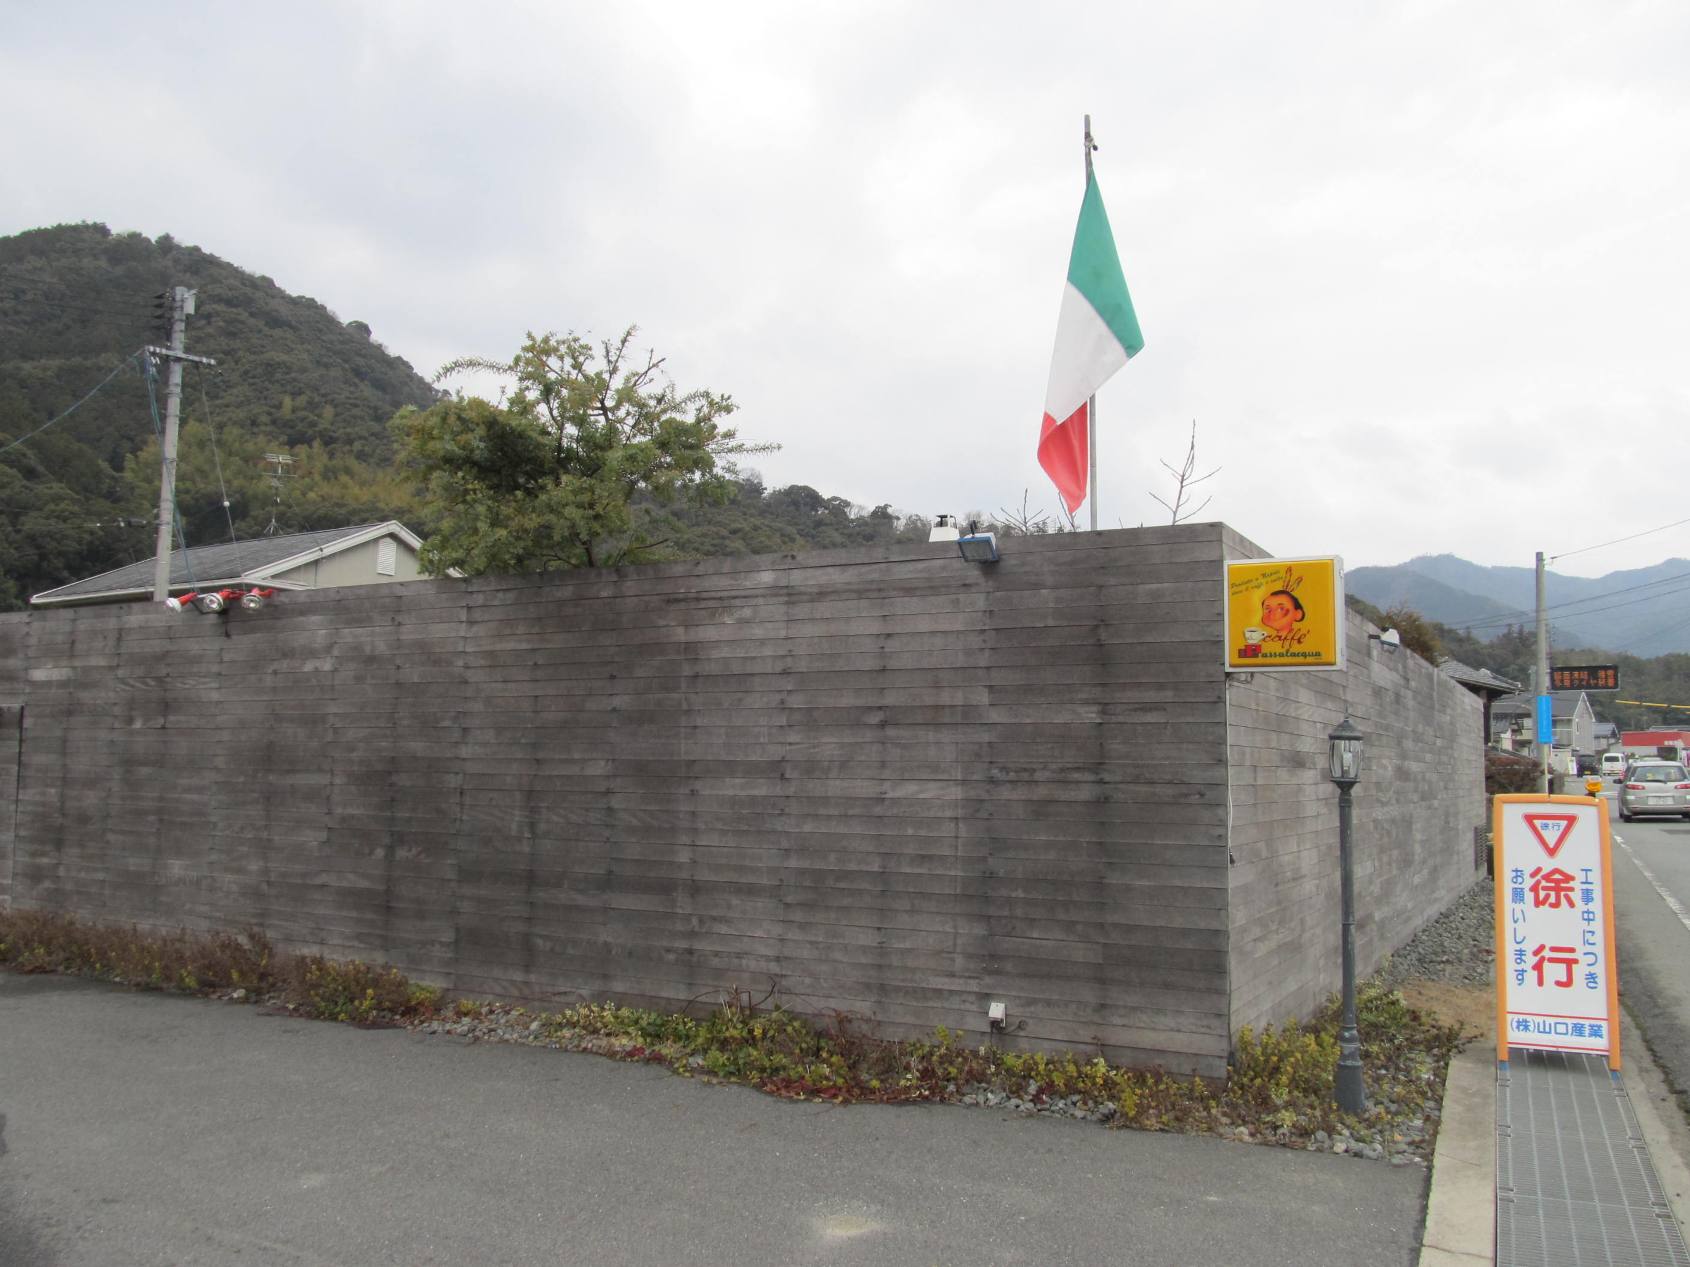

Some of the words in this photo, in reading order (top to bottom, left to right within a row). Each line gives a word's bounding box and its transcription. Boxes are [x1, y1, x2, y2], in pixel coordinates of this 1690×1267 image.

[1540, 821, 1562, 832] 徐行
[1510, 867, 1528, 987] お願いします
[1528, 865, 1580, 989] 徐行
[1579, 868, 1599, 990] 工事中につき
[1510, 1017, 1604, 1040] (株)山口産業
